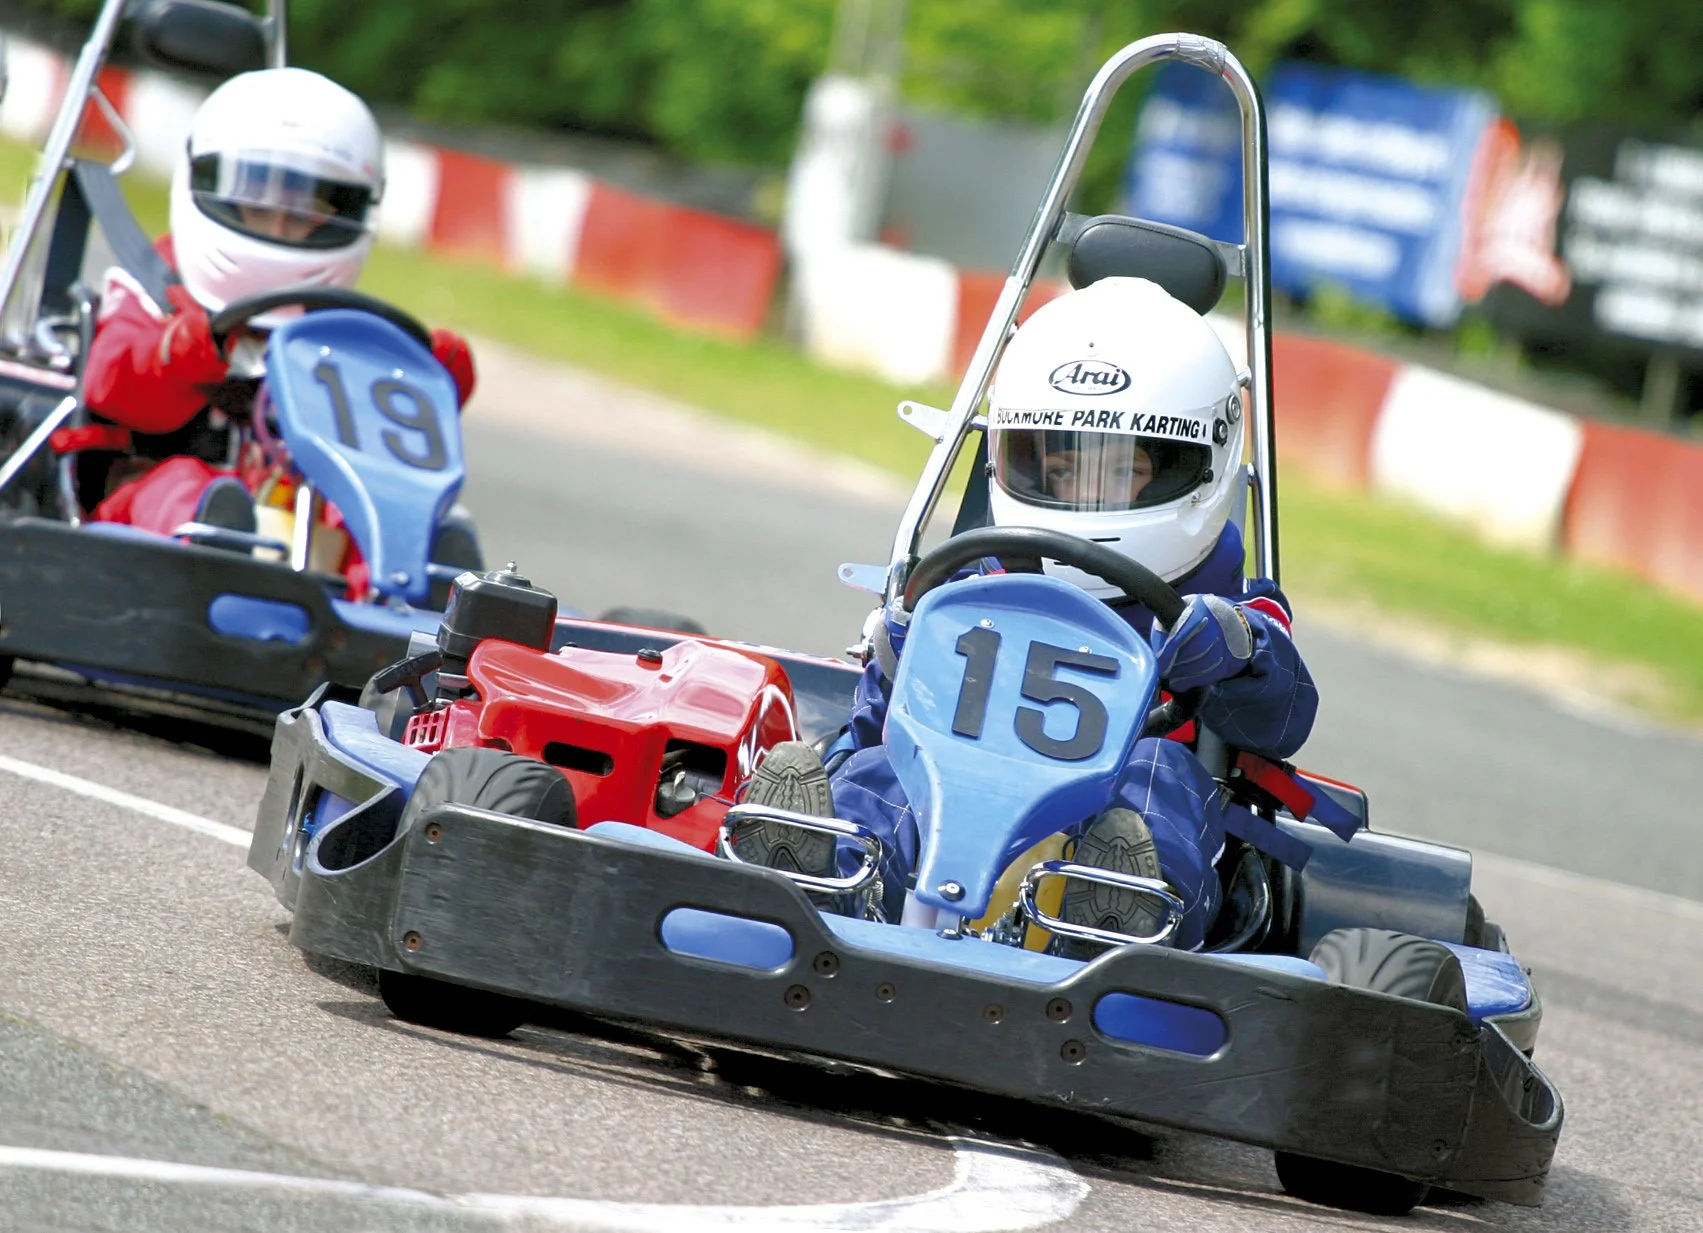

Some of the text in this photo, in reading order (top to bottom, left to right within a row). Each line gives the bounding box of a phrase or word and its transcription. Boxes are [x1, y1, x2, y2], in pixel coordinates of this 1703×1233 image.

[1054, 363, 1120, 386] Arai
[314, 361, 448, 471] 19
[1071, 410, 1127, 430] PARK
[1129, 412, 1201, 439] KARTING
[952, 626, 1119, 761] 15
